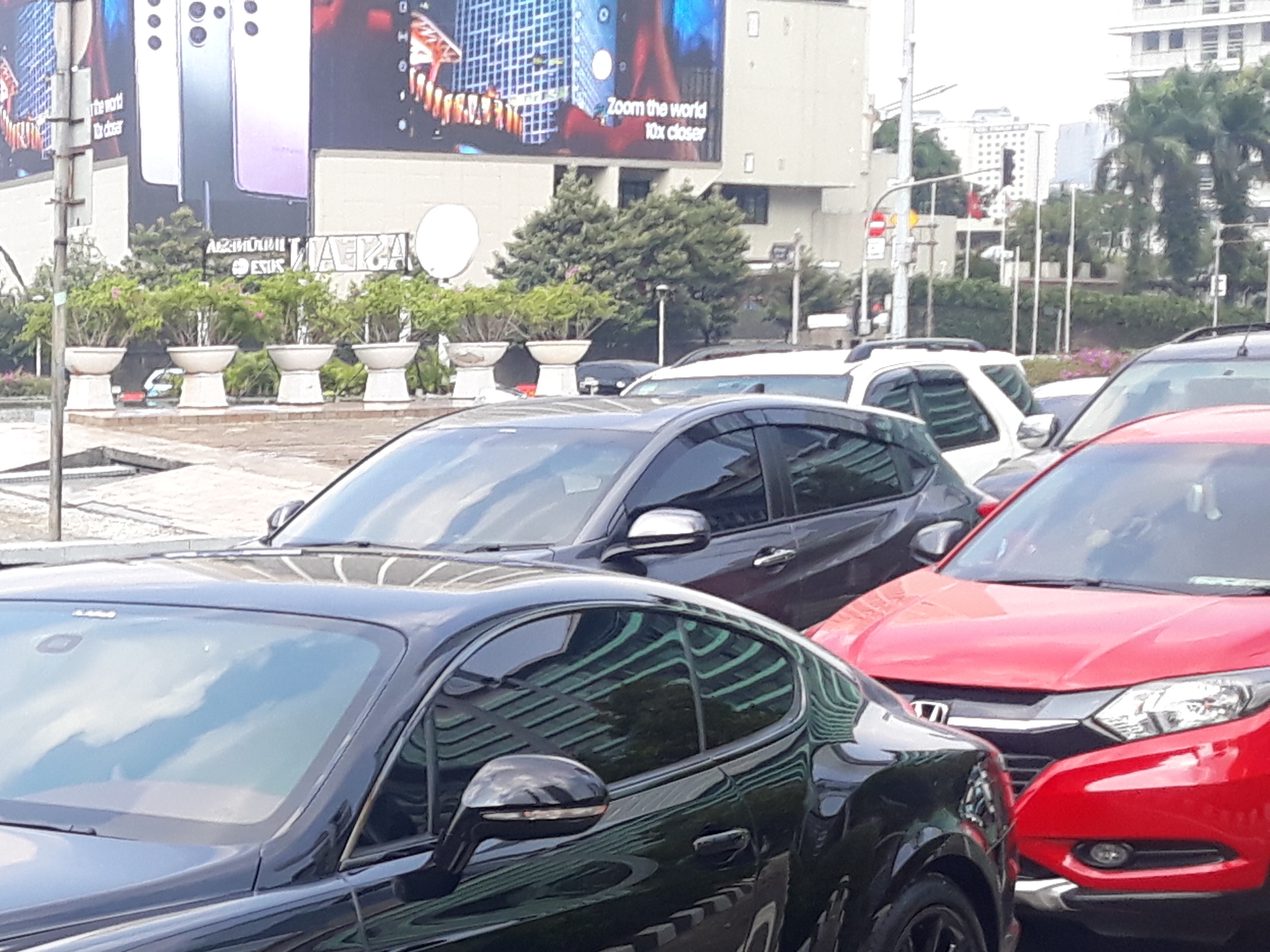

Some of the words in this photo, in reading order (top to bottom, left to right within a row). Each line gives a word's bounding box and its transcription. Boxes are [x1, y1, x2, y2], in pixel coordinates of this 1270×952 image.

[607, 97, 645, 116] Zoom
[646, 99, 668, 117] the
[670, 101, 708, 119] world
[645, 122, 665, 140] 10x
[667, 123, 707, 141] closer
